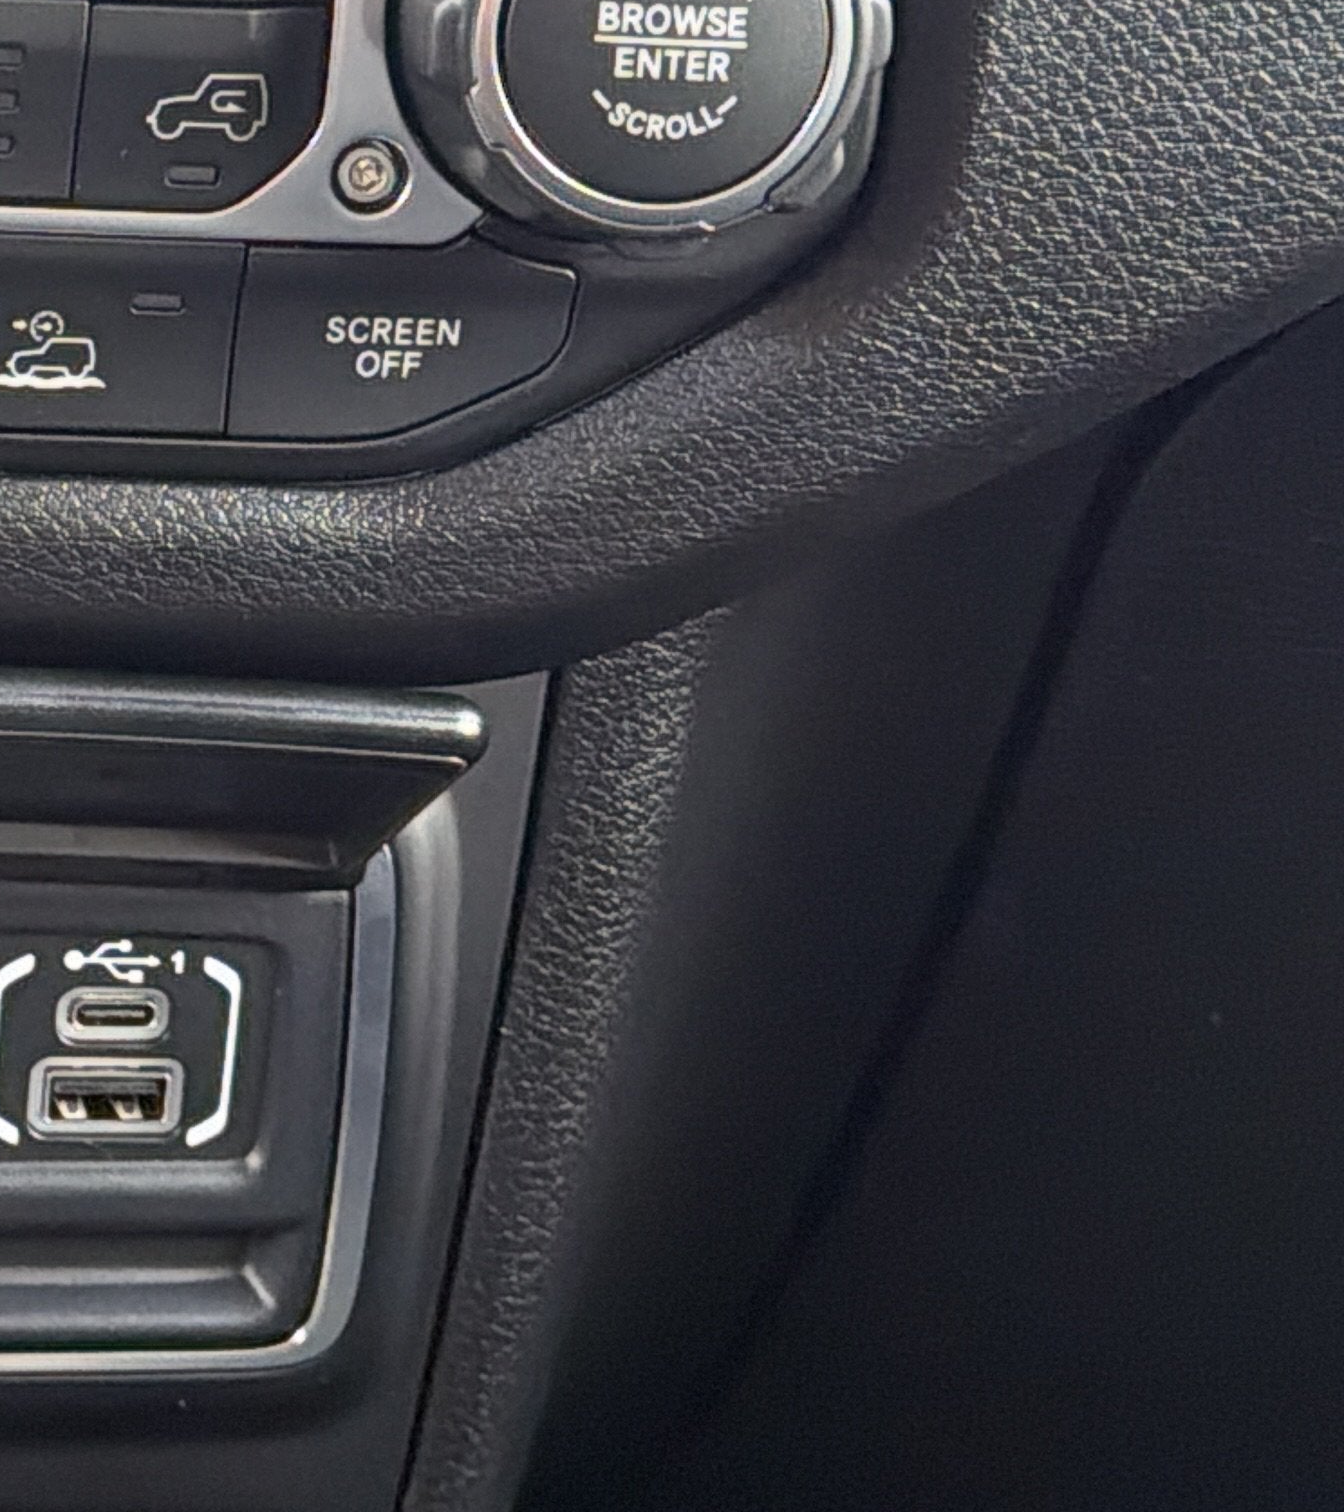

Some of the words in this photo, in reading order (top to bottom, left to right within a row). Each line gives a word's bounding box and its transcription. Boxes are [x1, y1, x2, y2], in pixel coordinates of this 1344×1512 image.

[597, 0, 749, 39] BROWSE
[613, 46, 731, 82] ENTER
[608, 102, 724, 140] SCROLL
[324, 316, 461, 348] SCREEN
[354, 349, 423, 381] OFF
[170, 951, 185, 974] 1
